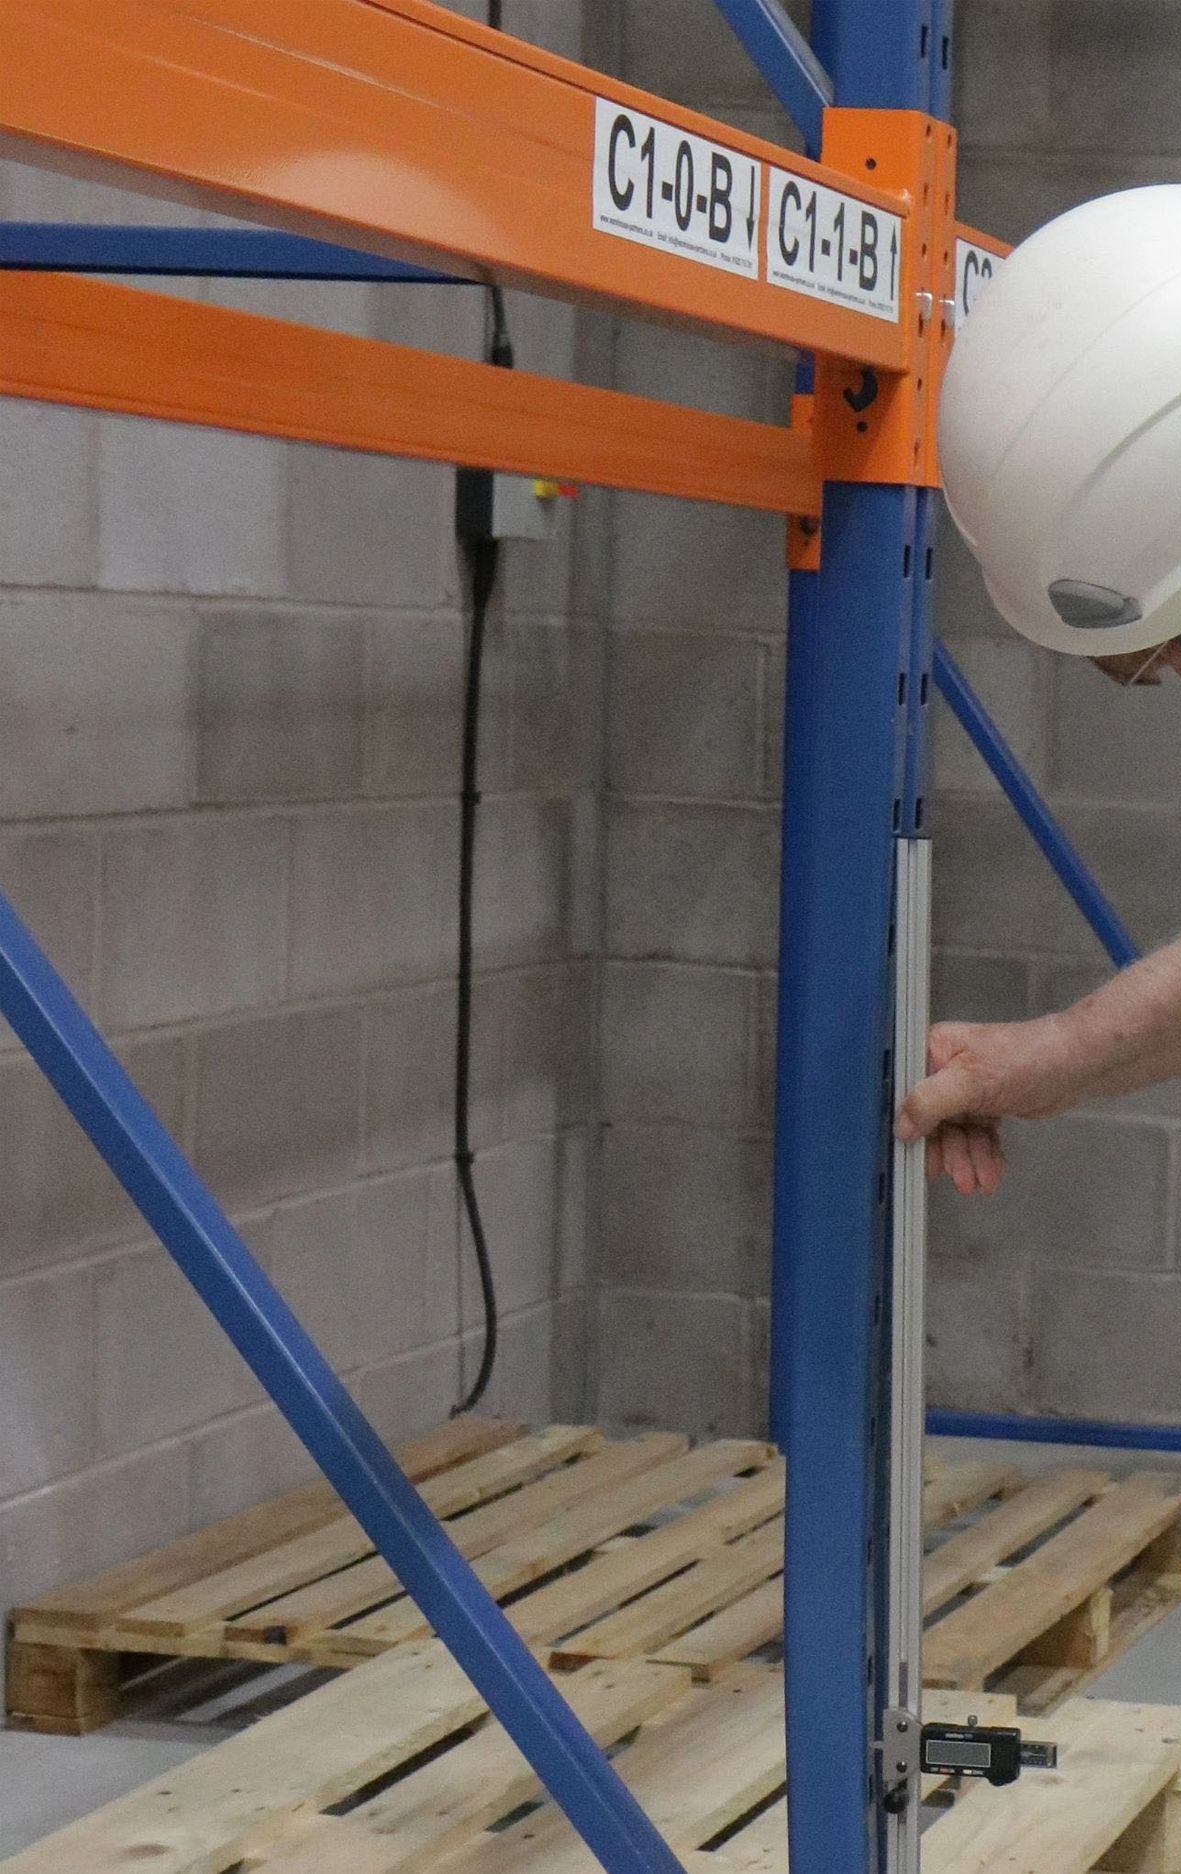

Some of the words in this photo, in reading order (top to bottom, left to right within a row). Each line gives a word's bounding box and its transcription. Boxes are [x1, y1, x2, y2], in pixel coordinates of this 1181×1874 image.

[608, 114, 732, 243] C1-0-B
[779, 181, 878, 291] C1-1-B
[963, 250, 992, 317] C
